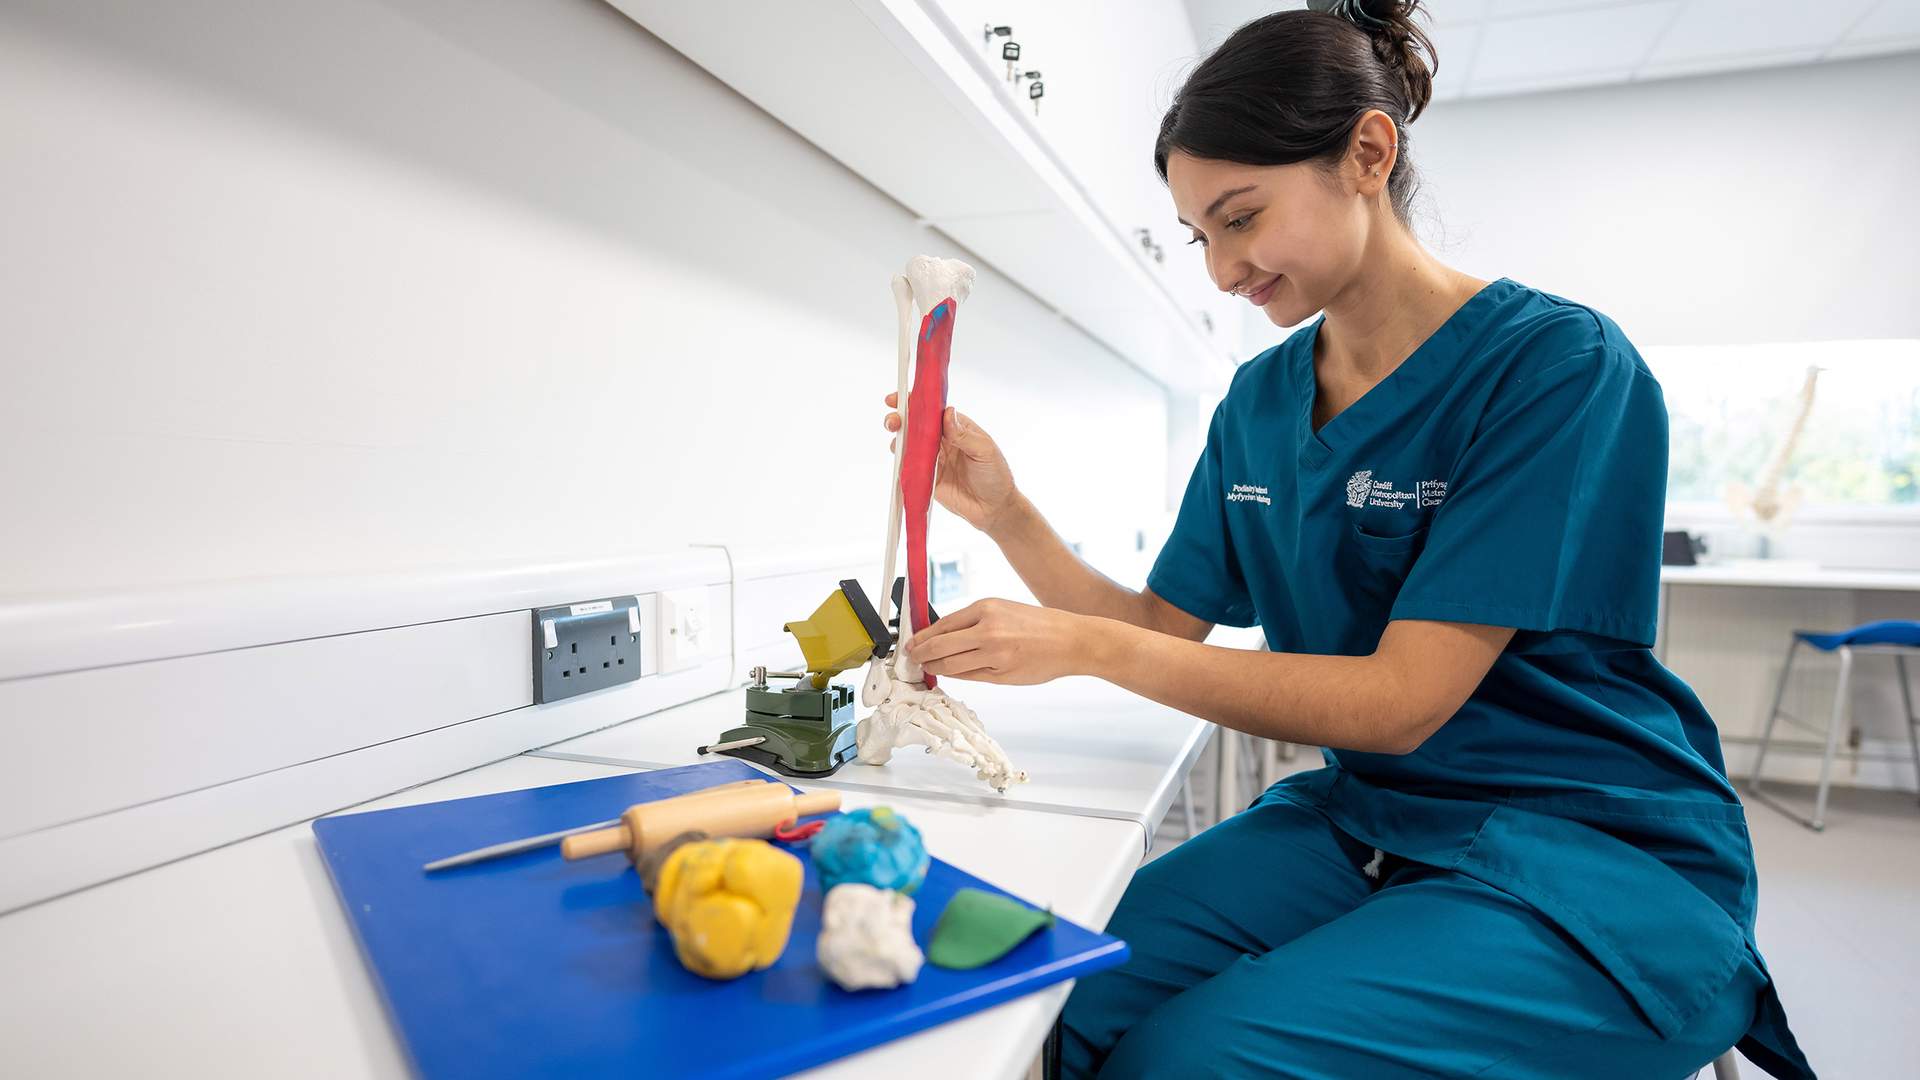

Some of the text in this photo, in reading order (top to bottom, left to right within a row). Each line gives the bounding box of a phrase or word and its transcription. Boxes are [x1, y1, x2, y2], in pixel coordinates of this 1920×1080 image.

[1372, 480, 1393, 490] Cardiff
[1370, 489, 1416, 501] Metropolitan
[1369, 497, 1406, 510] University
